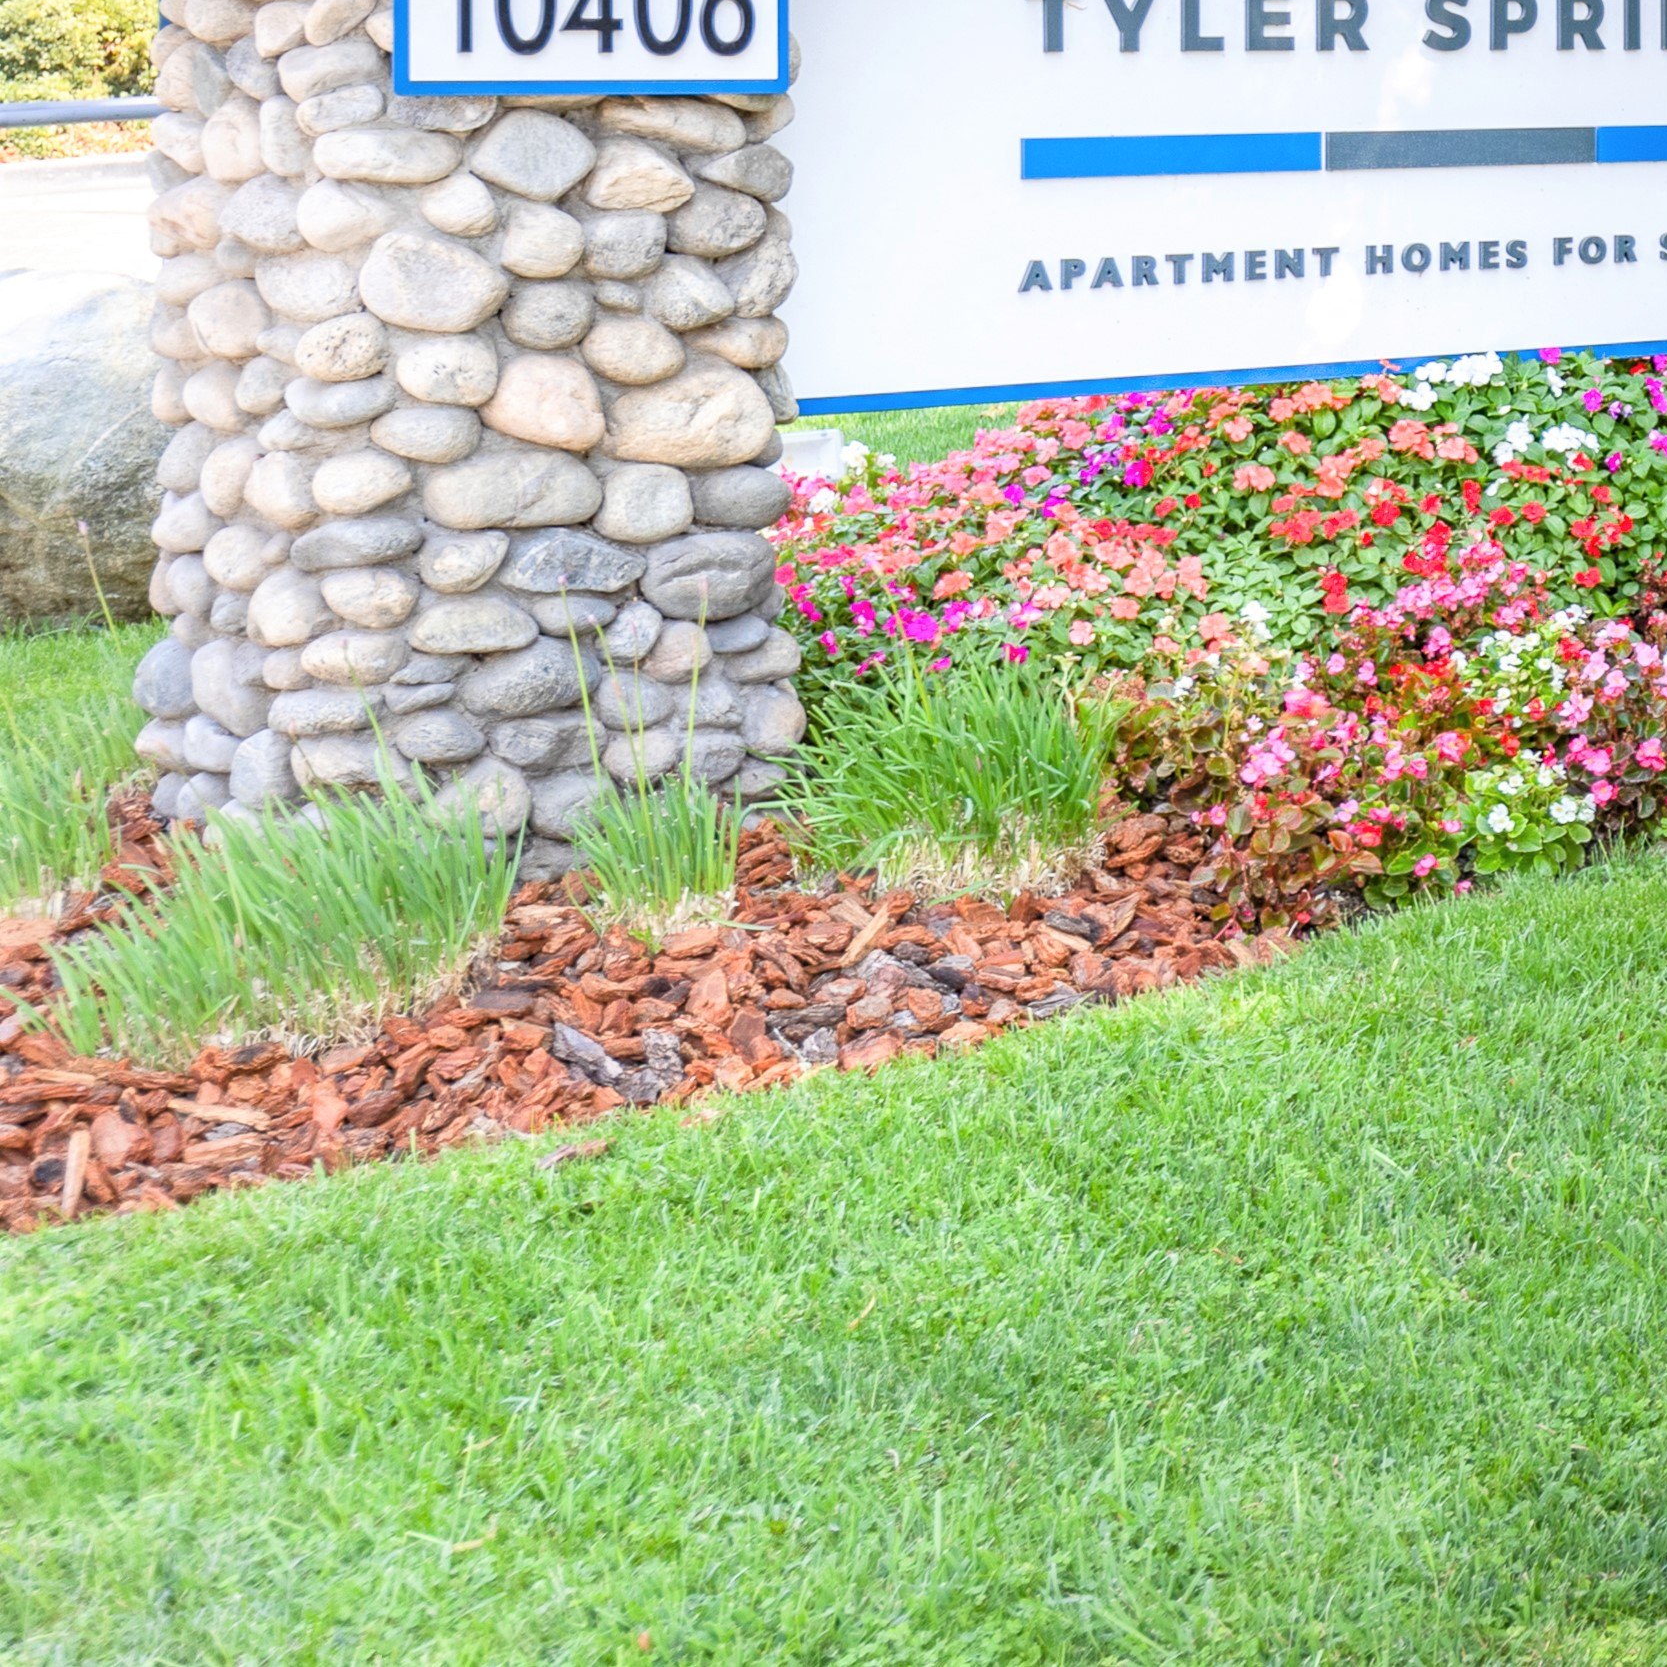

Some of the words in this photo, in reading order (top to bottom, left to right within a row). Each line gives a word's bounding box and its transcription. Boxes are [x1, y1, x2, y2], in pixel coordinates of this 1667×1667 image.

[1018, 245, 1340, 294] APARTMENT
[1364, 239, 1529, 276] HOMES
[1552, 234, 1639, 267] FOR
